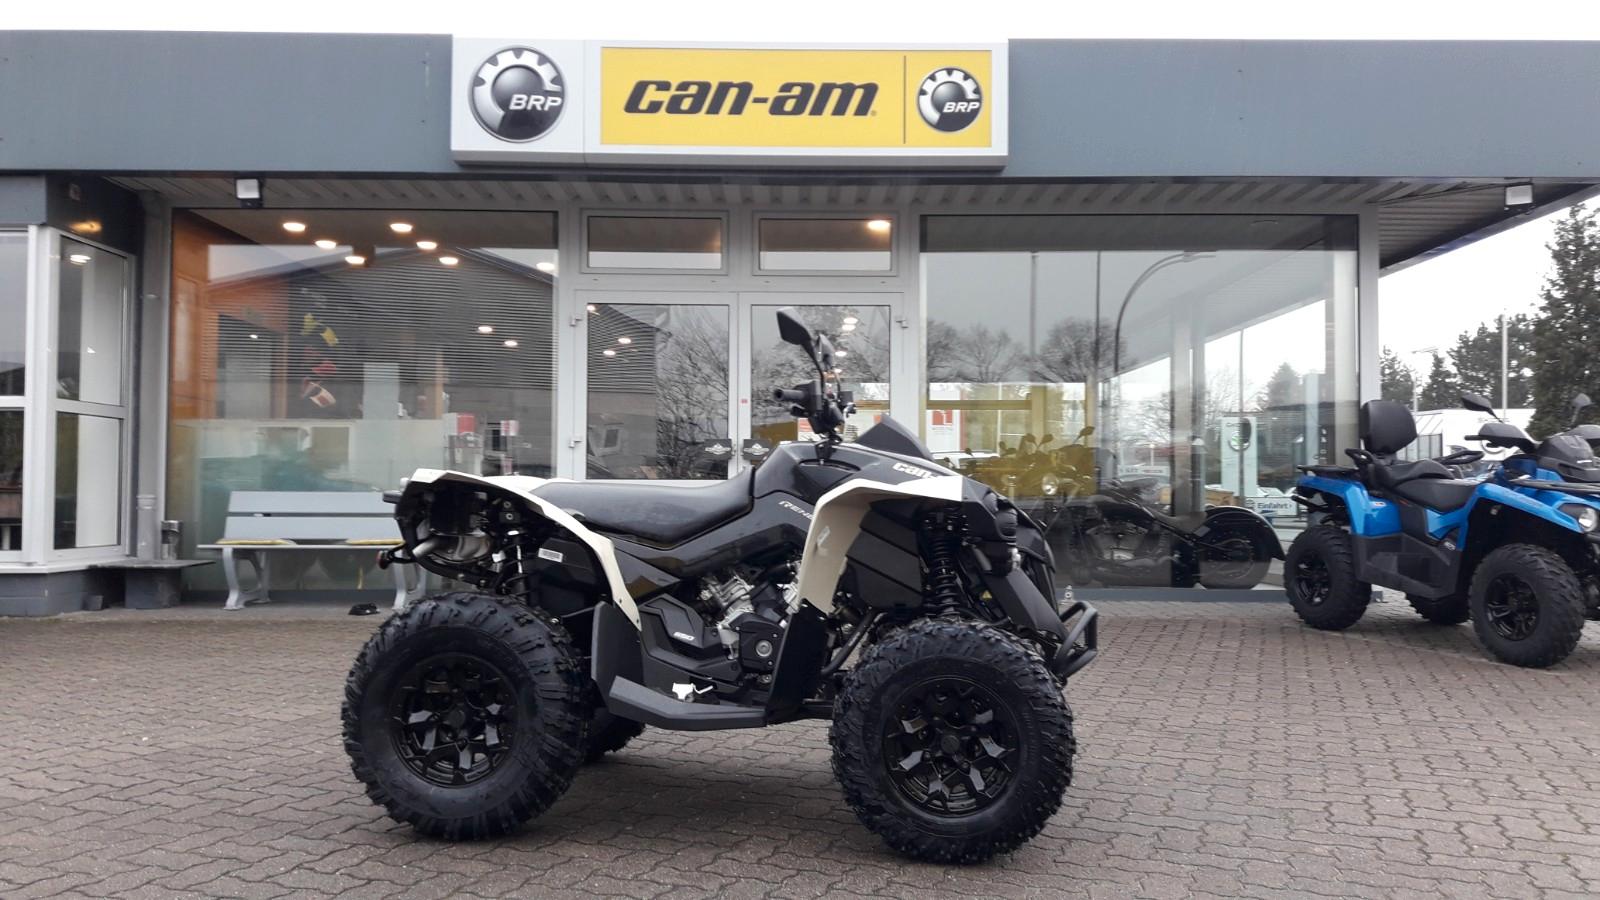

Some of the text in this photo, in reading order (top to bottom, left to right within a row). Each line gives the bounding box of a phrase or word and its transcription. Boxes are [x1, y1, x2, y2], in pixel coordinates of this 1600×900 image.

[509, 94, 563, 111] BRP
[624, 80, 879, 116] can-am
[943, 101, 980, 113] BRP
